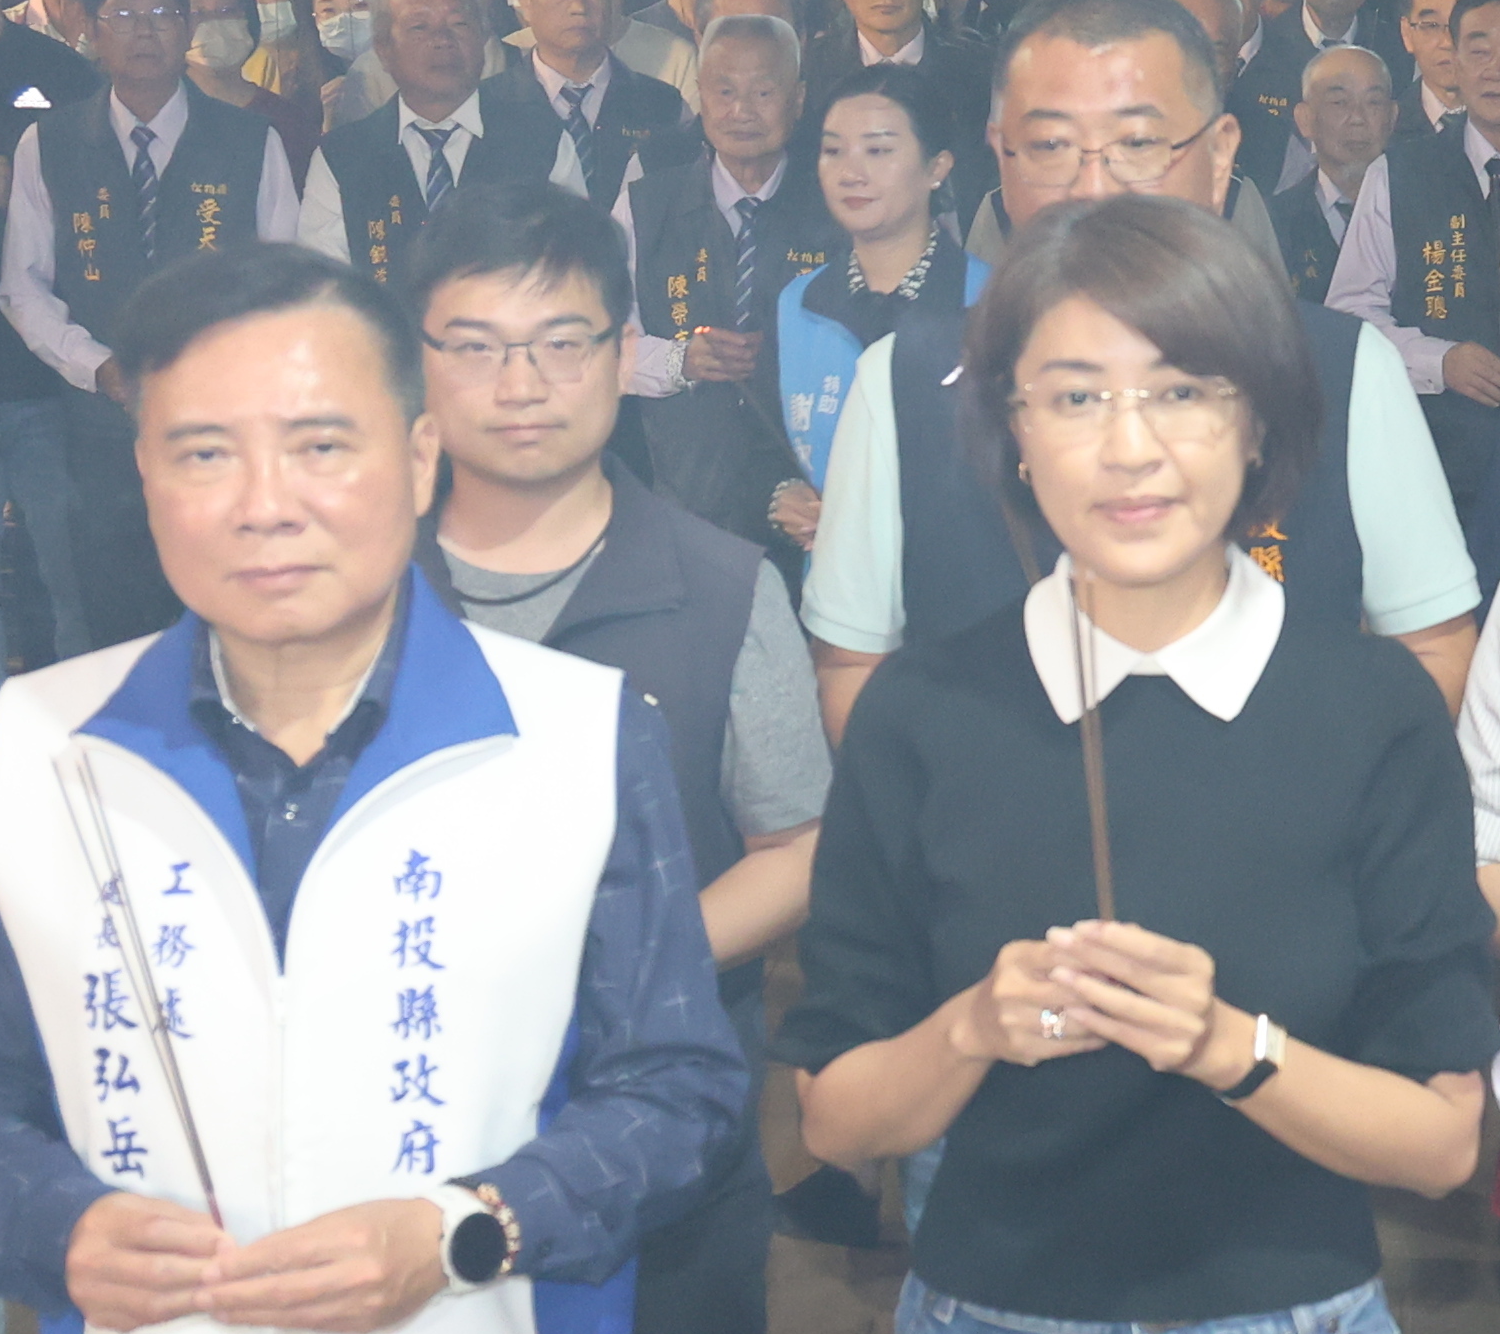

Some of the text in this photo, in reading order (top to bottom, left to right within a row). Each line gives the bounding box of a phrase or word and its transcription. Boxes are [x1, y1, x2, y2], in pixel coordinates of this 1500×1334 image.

[1449, 213, 1468, 298] 副主任委員
[390, 848, 446, 1175] 南投縣政府
